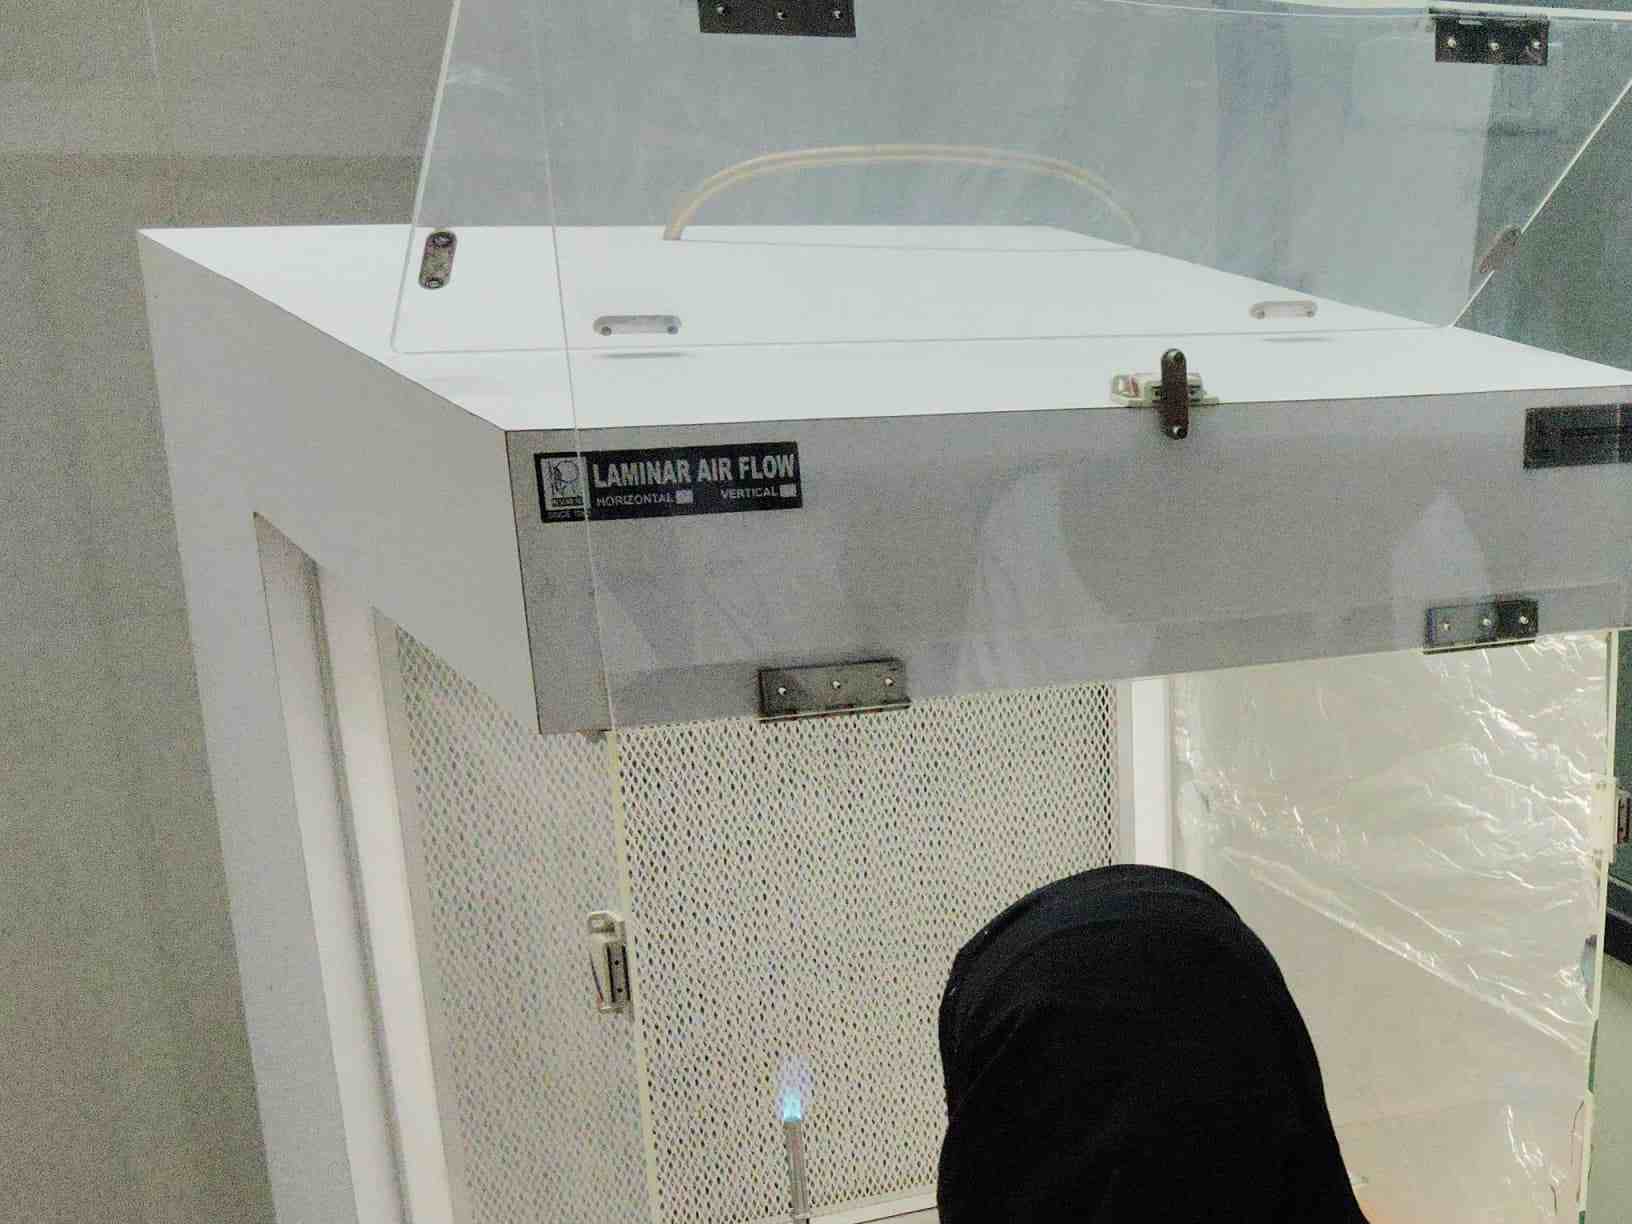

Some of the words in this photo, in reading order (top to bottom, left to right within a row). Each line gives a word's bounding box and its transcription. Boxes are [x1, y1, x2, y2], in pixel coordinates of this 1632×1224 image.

[592, 460, 691, 488] LAMINAR
[697, 457, 733, 483] AIR
[738, 454, 795, 480] FLOW
[596, 493, 673, 507] HORIZONTAL
[720, 487, 779, 500] VERTICAL
